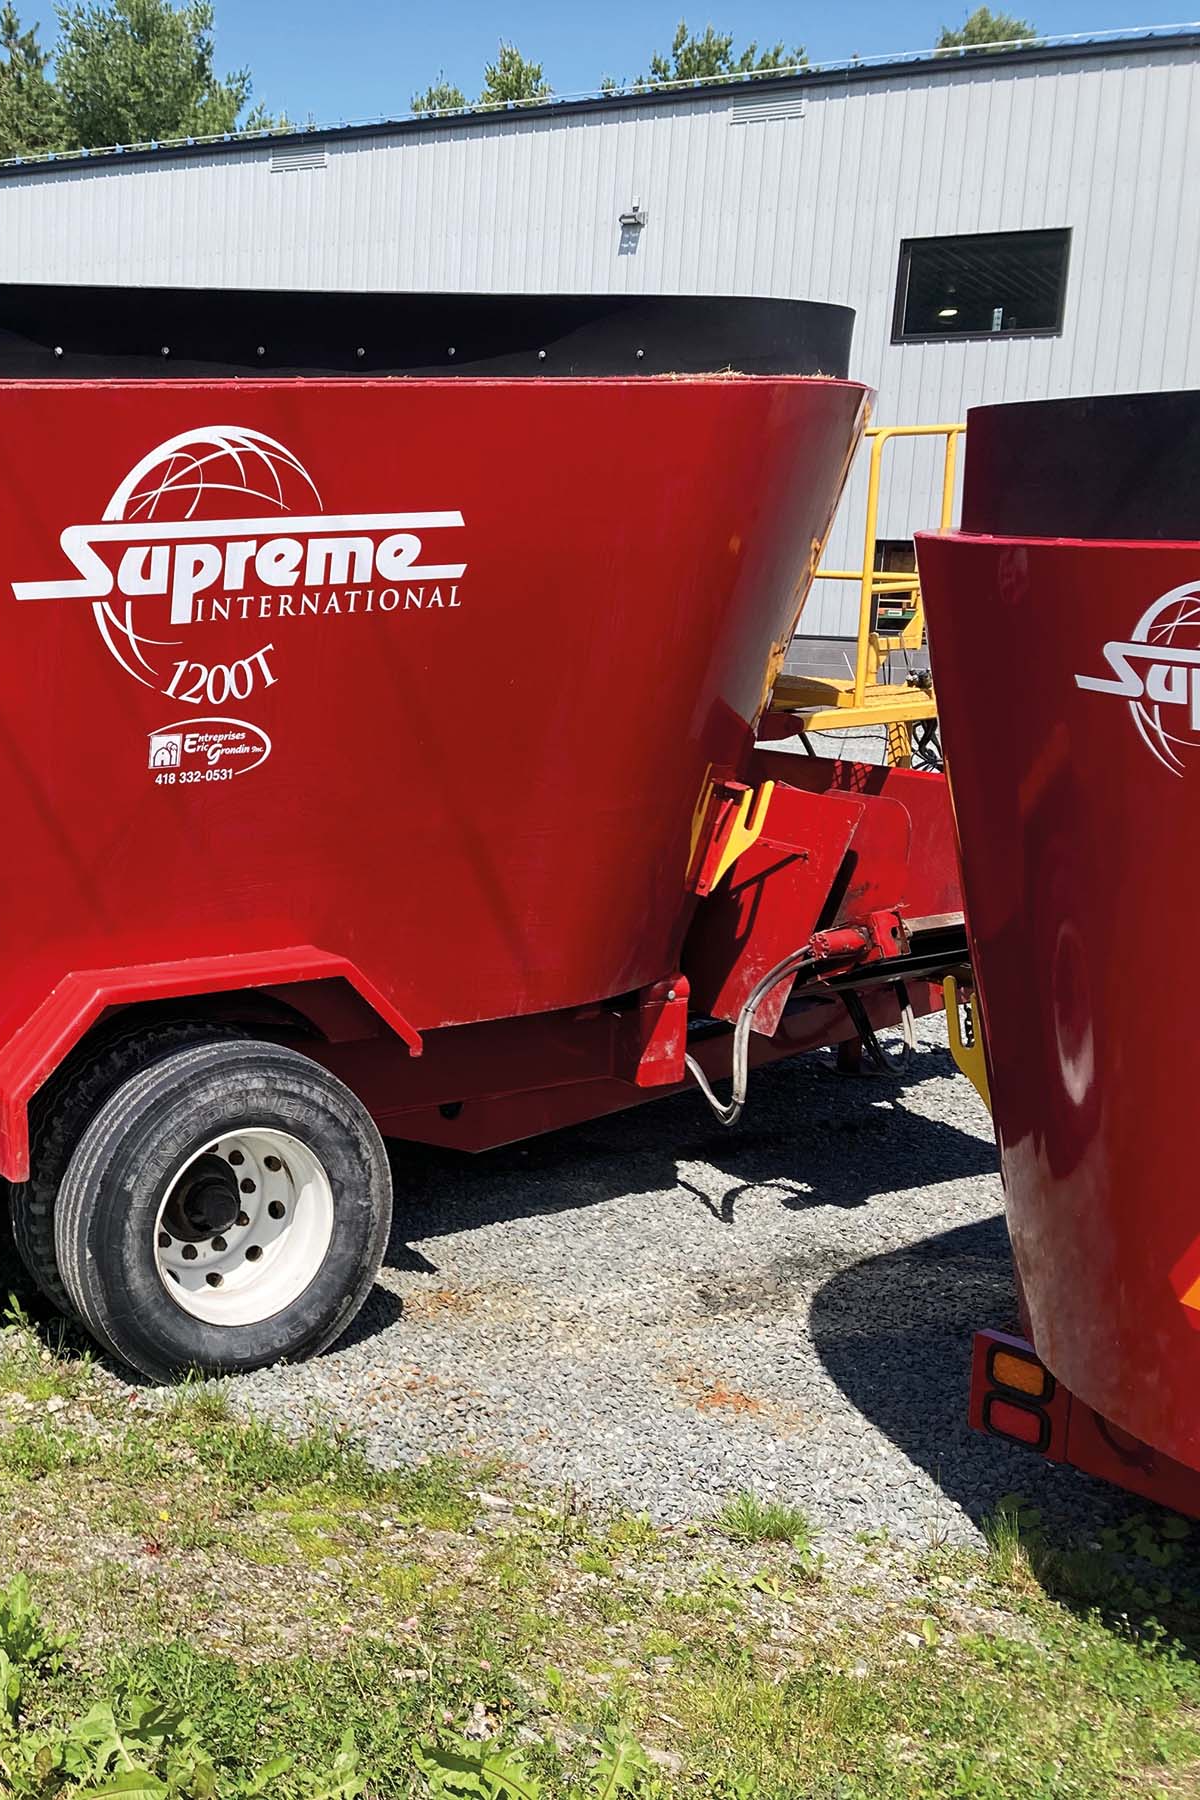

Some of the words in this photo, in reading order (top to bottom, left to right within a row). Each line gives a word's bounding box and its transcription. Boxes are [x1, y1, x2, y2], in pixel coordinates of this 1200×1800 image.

[11, 511, 468, 625] Supreme
[195, 585, 462, 622] INTERNATIONAL
[160, 643, 279, 704] 1200T
[184, 737, 209, 753] Eric
[207, 743, 250, 765] Grondin
[185, 731, 246, 743] Entreprises
[155, 773, 176, 785] 418
[179, 768, 233, 784] 332-0531
[131, 1124, 201, 1208] WIND
[200, 1094, 319, 1131] POWER
